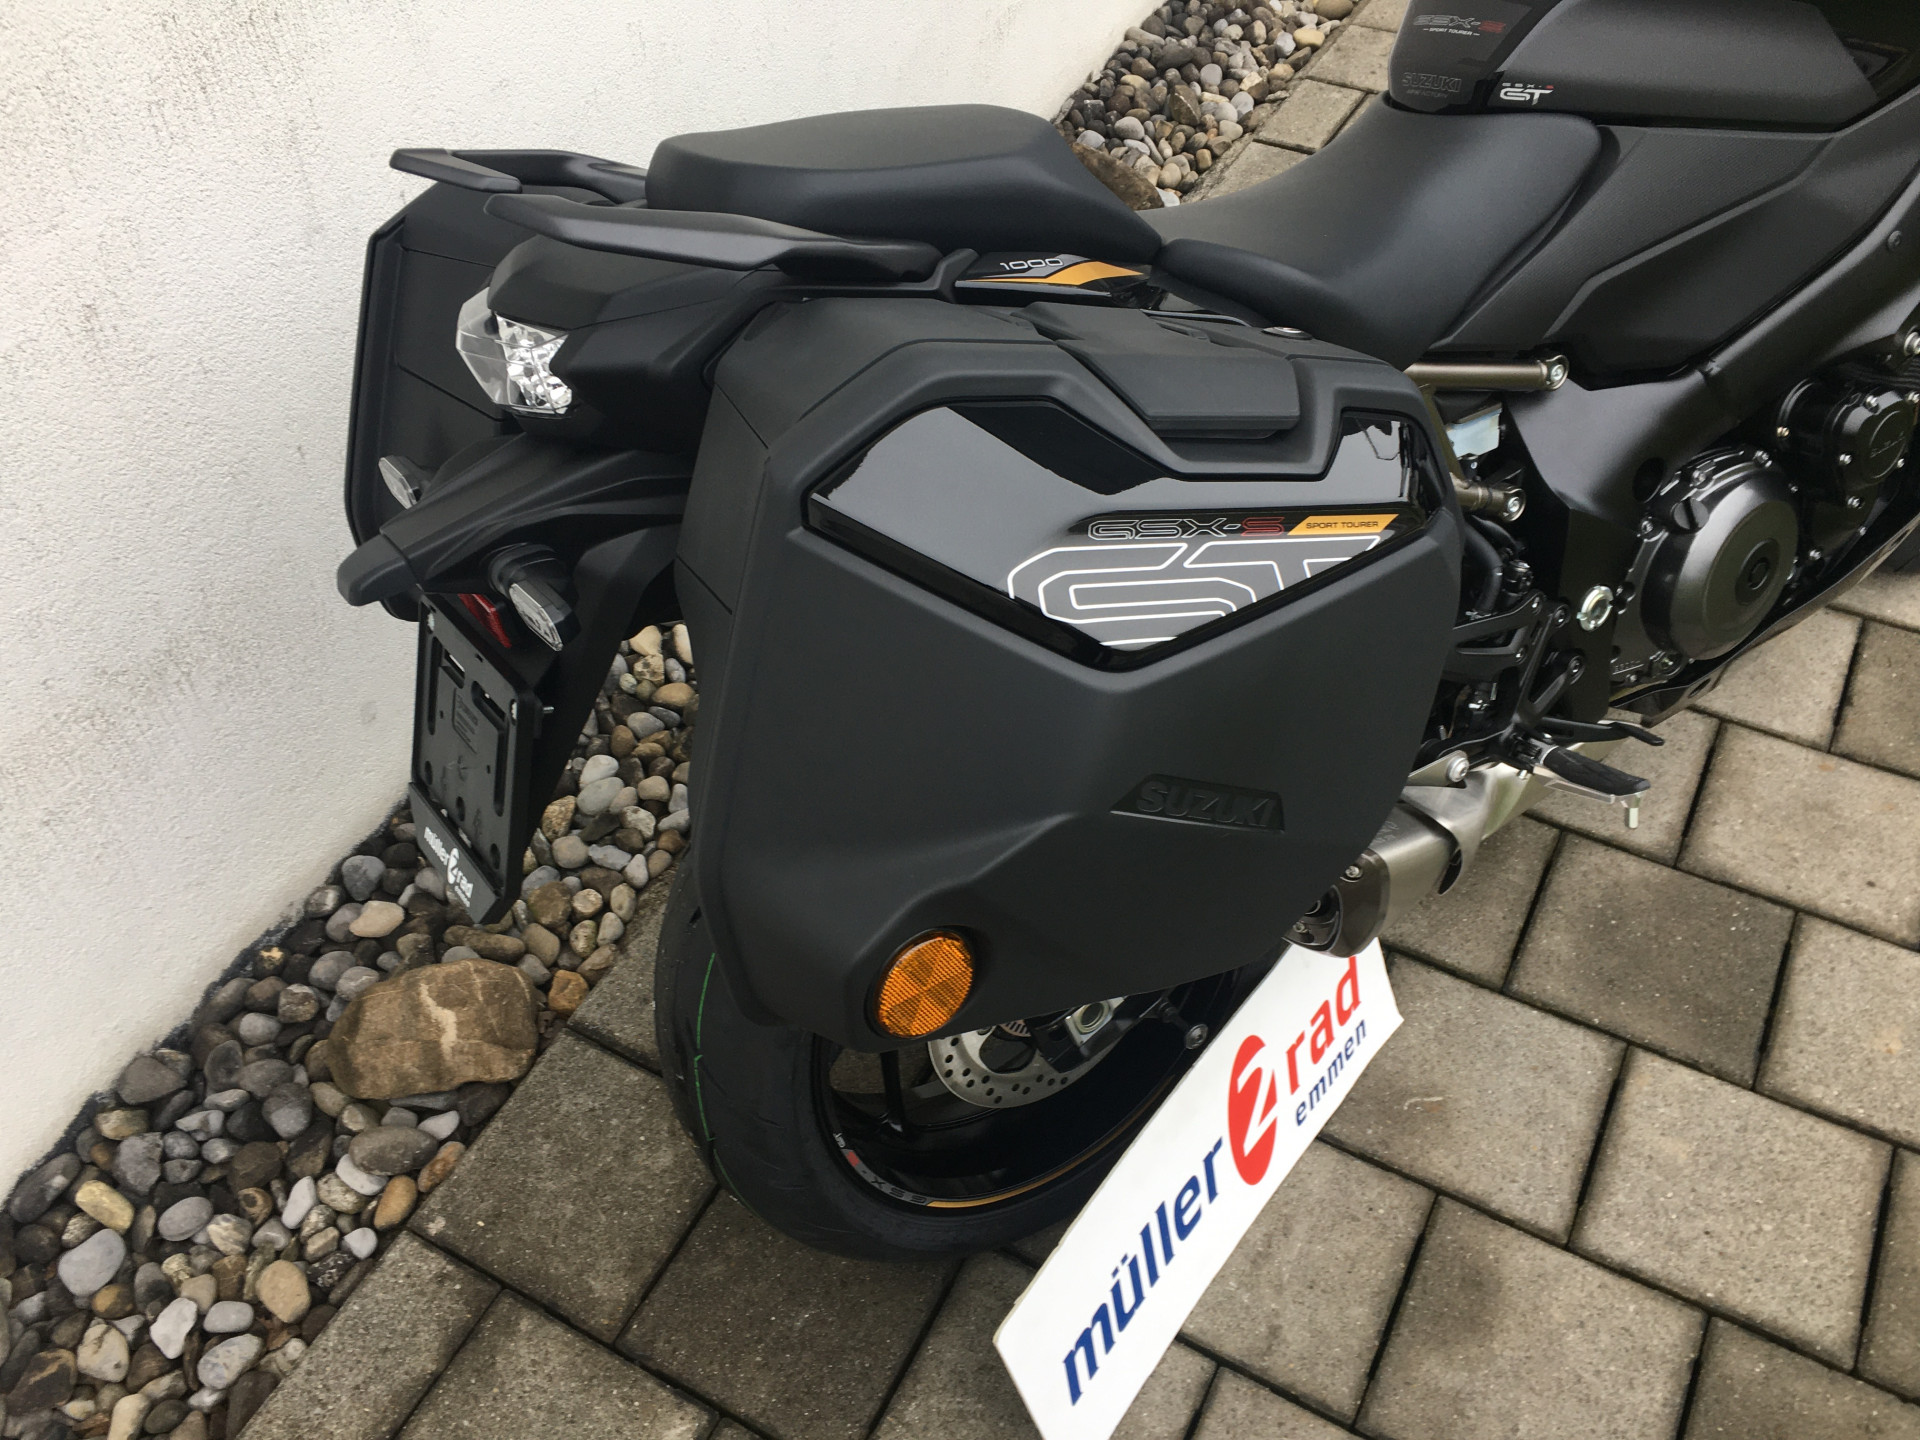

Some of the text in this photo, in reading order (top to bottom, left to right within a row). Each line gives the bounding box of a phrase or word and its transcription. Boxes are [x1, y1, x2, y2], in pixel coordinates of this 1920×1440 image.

[1402, 72, 1462, 93] SUZUKI
[1500, 87, 1553, 105] GT
[1000, 258, 1063, 271] 1000
[1088, 517, 1285, 540] GSX-S
[1136, 780, 1278, 828] SUZUKI
[1295, 1019, 1367, 1127] emmen
[1062, 1136, 1223, 1406] müller
